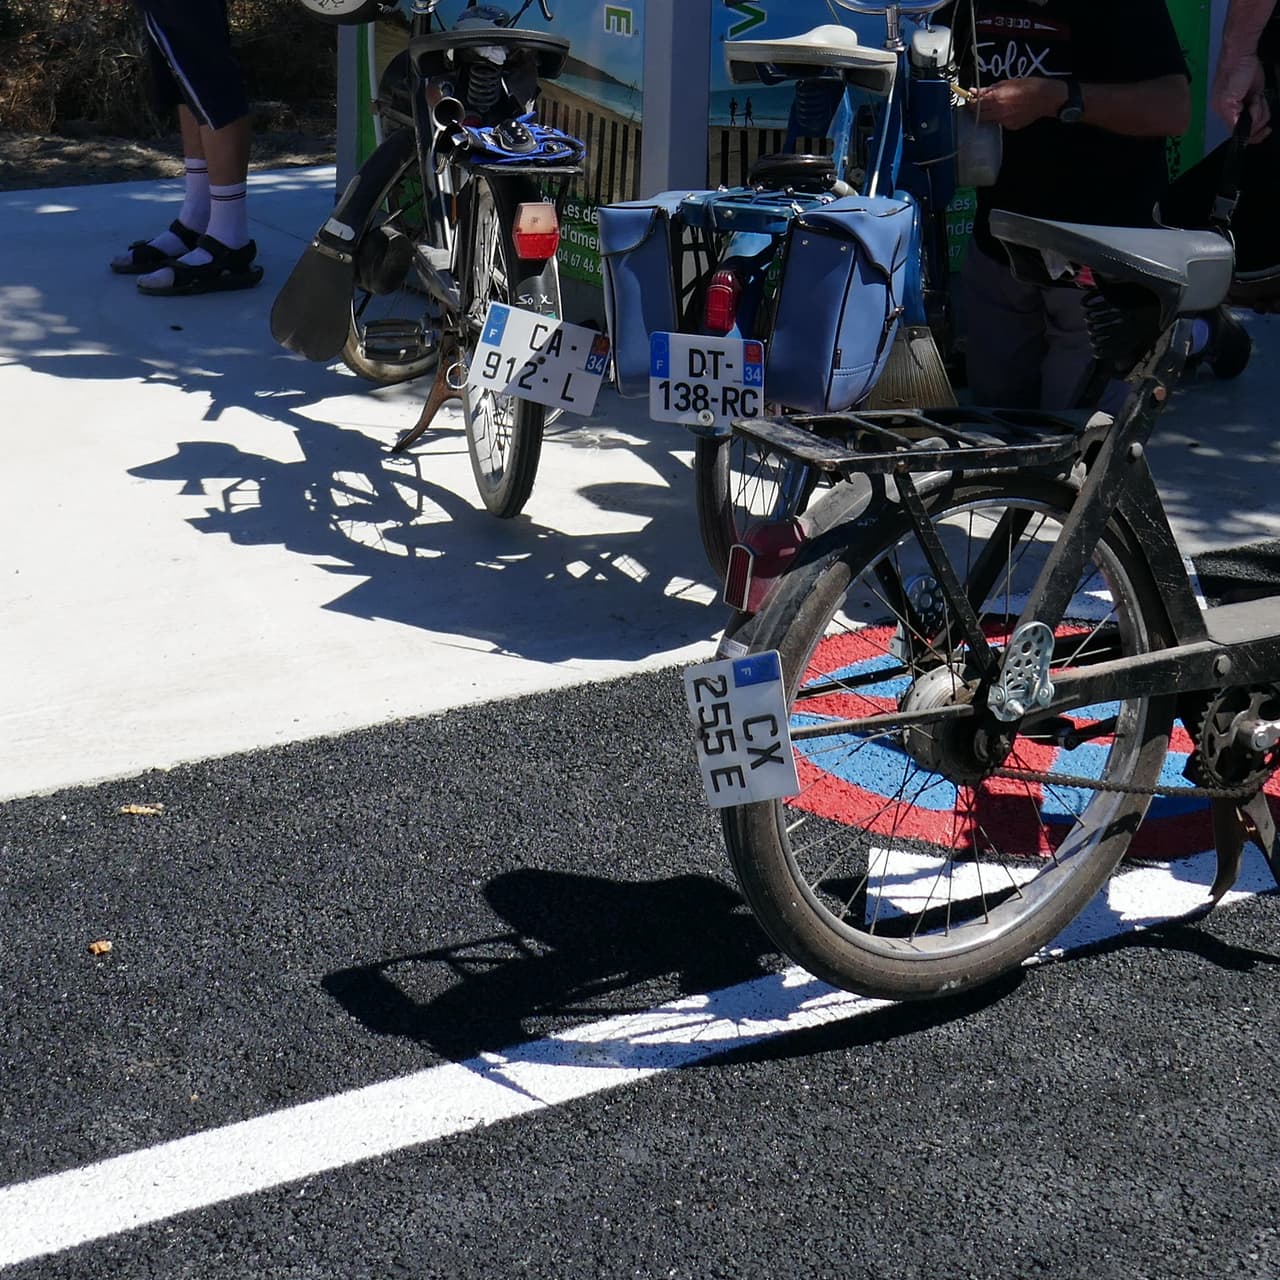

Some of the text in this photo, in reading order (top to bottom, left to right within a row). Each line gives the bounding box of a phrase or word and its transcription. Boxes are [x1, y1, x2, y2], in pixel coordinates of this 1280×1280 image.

[557, 248, 568, 264] 04
[570, 254, 581, 267] 67
[583, 259, 593, 273] 46
[489, 328, 498, 338] F
[587, 355, 603, 373] 34
[656, 359, 664, 370] F
[745, 366, 762, 381] 34
[658, 380, 759, 418] 138-RC
[740, 666, 752, 677] F
[742, 713, 785, 770] CX
